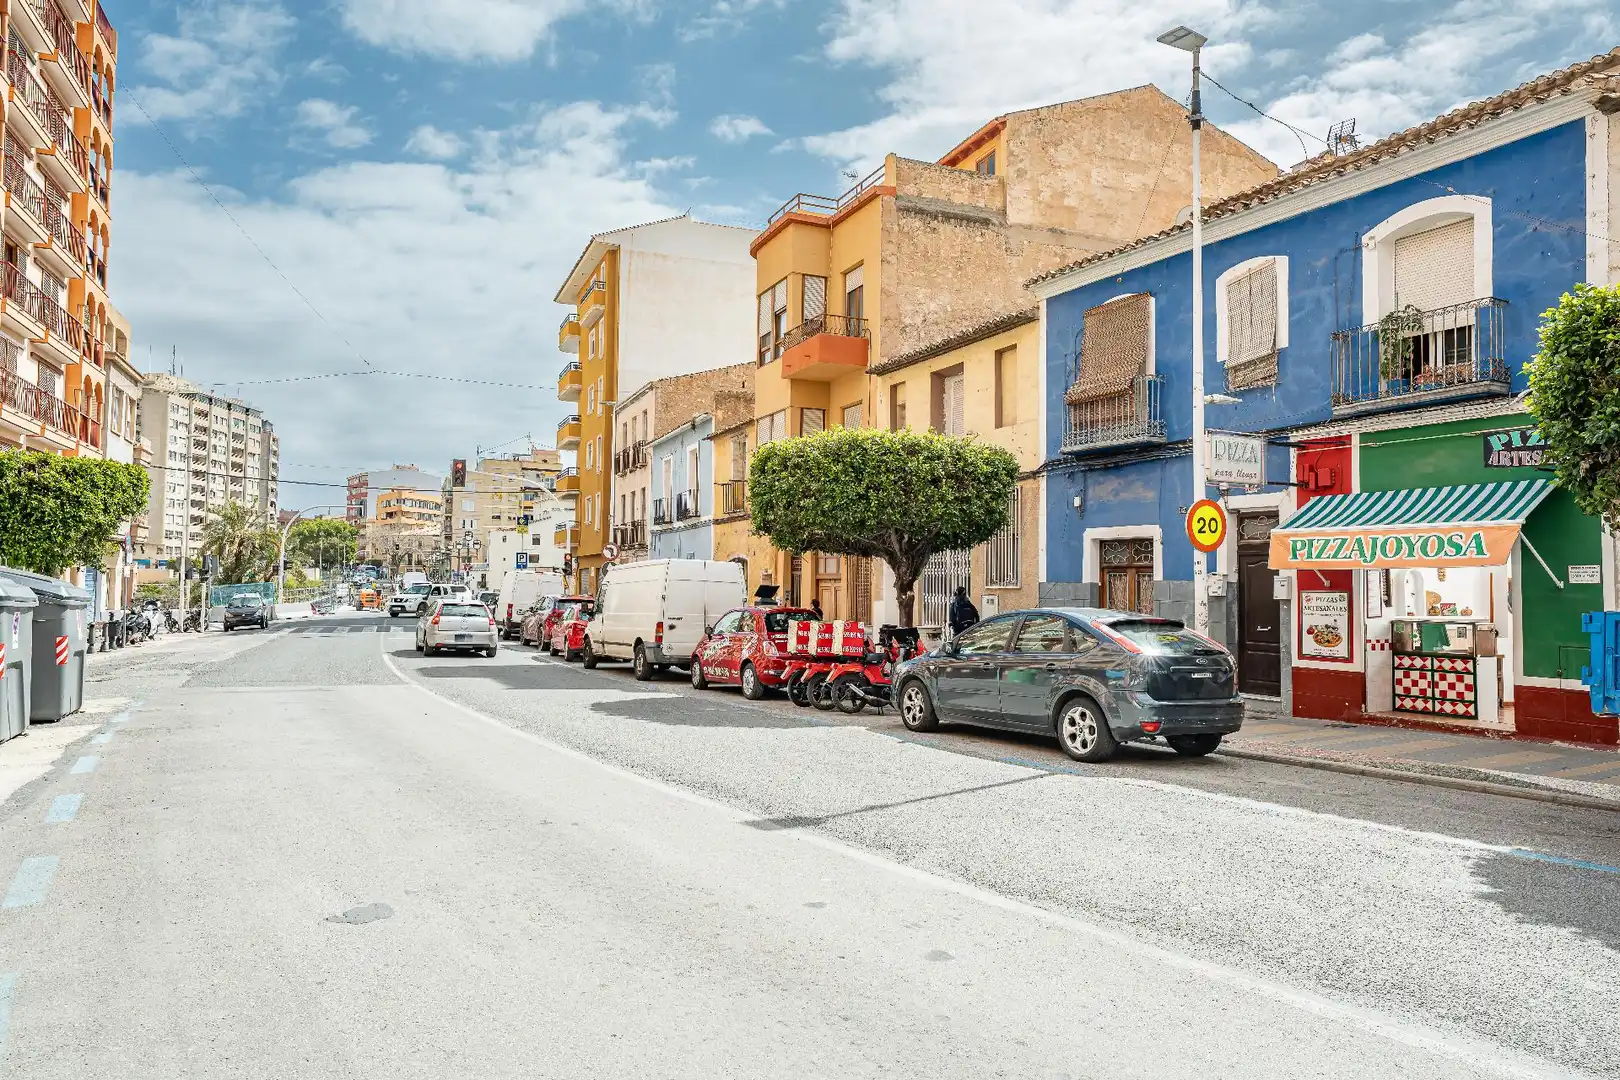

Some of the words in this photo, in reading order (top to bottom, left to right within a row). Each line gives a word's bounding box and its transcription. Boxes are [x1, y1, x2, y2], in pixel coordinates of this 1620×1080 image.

[1487, 430, 1551, 451] PIZ
[1197, 516, 1218, 534] 20
[1289, 532, 1488, 564] PIZZAJOYOSA
